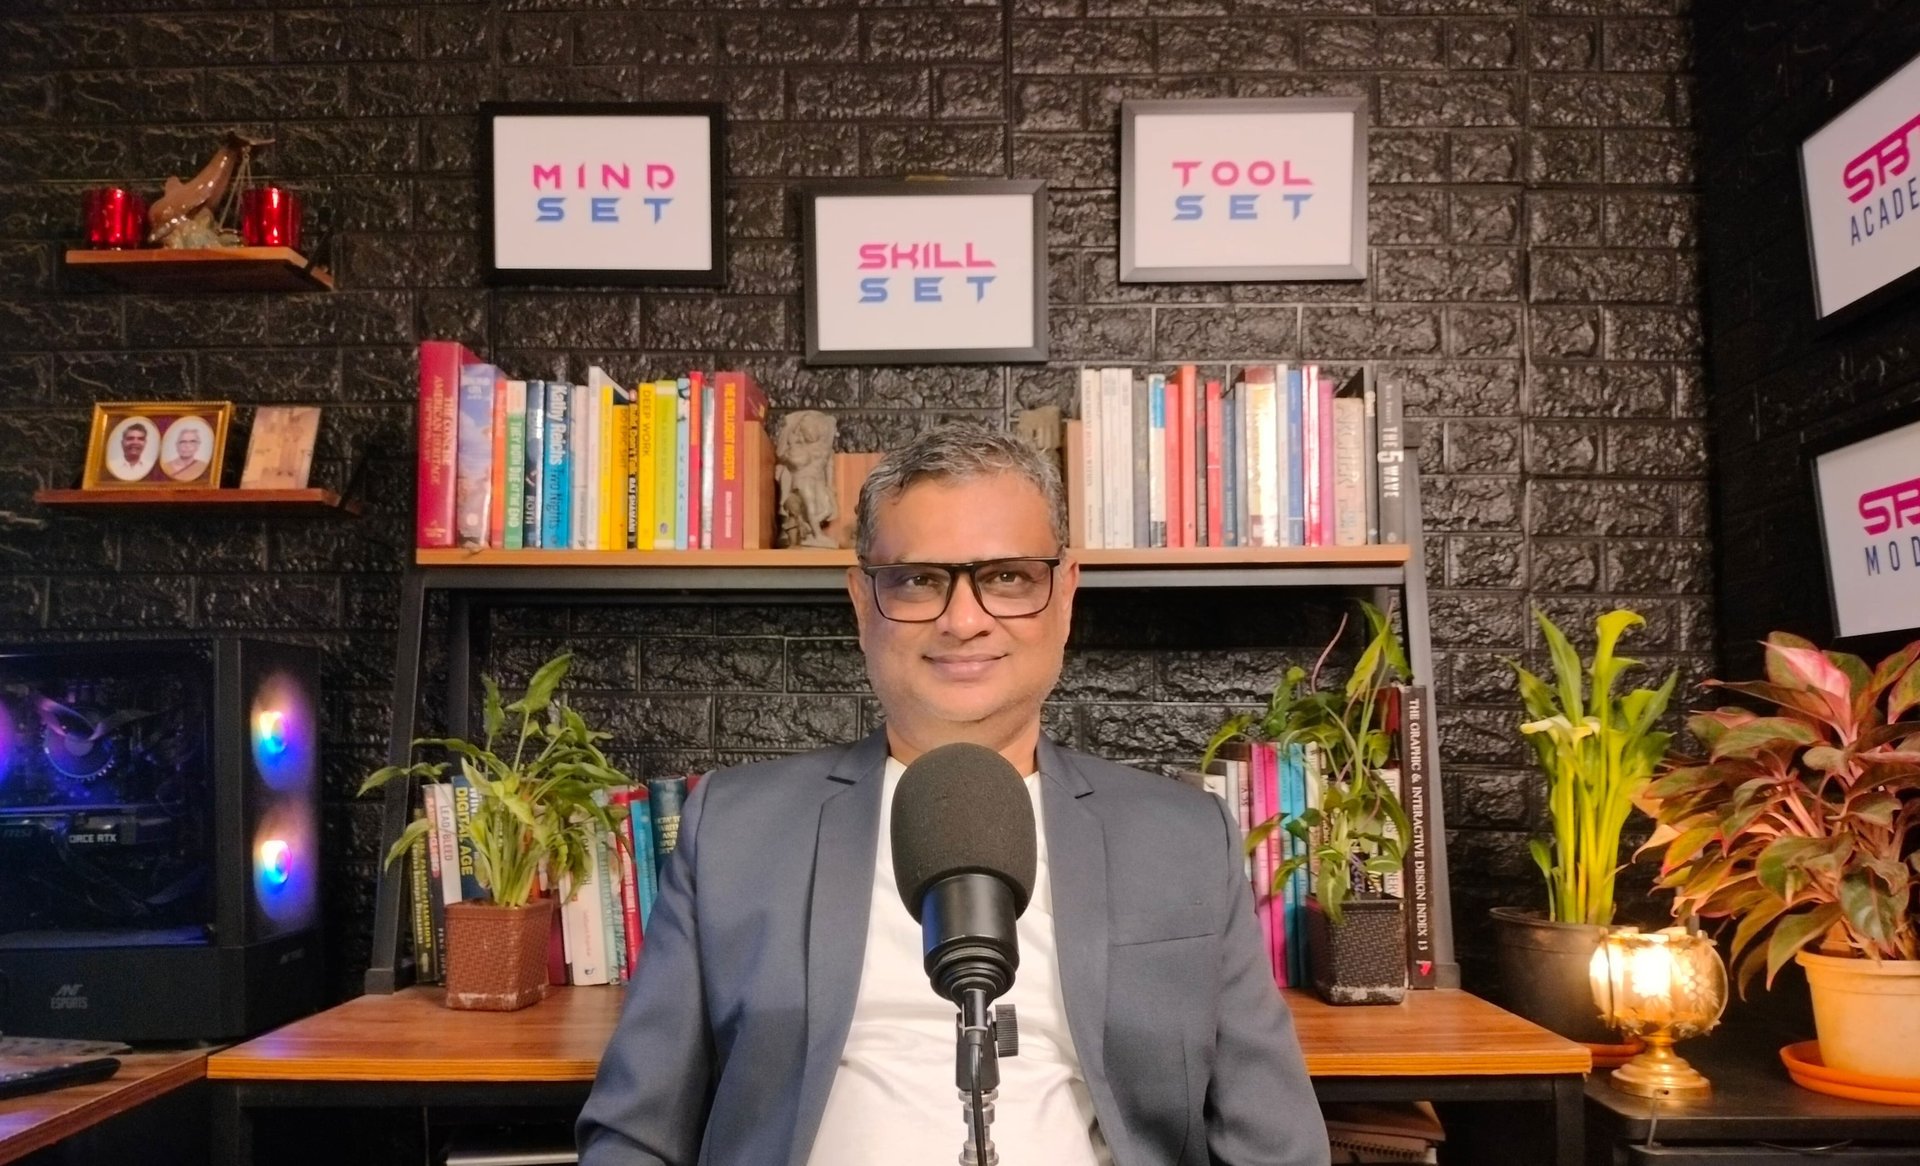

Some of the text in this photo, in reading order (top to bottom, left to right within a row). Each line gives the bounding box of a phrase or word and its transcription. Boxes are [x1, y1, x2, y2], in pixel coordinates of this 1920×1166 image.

[532, 163, 676, 190] MIND
[1173, 160, 1312, 187] TOOL
[537, 197, 675, 222] SET
[1173, 196, 1314, 221] SET
[1851, 177, 1920, 246] ACADE
[859, 243, 997, 270] SKILL
[859, 278, 997, 302] SET
[432, 376, 445, 431] AMERICAN
[642, 389, 651, 458] DEEP WORK
[1382, 426, 1399, 448] THE
[545, 386, 568, 530] Kathy Reichs Two Nights
[1377, 450, 1405, 464] 5
[508, 467, 520, 483] DIE
[1382, 465, 1400, 498] WAVE
[507, 508, 520, 527] END
[526, 495, 536, 525] ROTH
[96, 834, 117, 843] RTX
[456, 786, 473, 876] DIGITAL AGE
[1408, 699, 1428, 951] THE GRAPHIC & INTERACTIVE DESIGN INDEX 13
[51, 996, 89, 1010] ESPORTS
